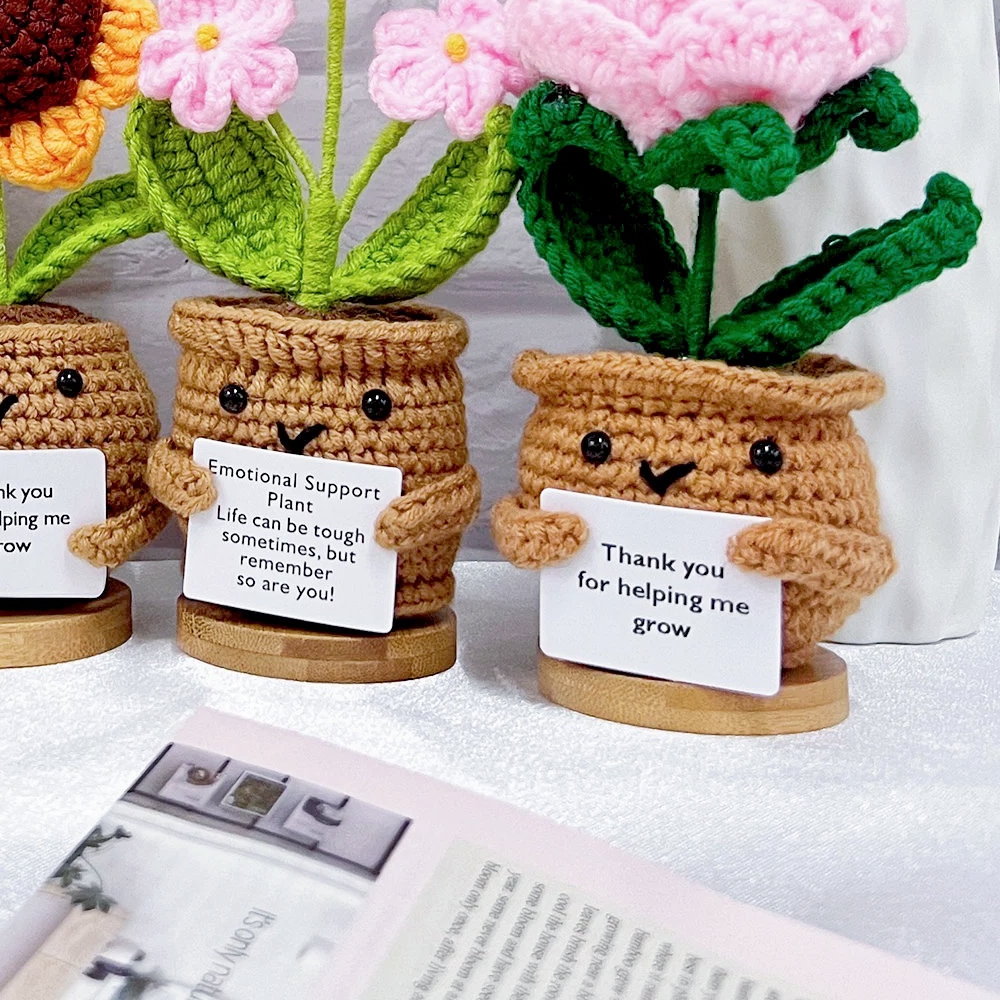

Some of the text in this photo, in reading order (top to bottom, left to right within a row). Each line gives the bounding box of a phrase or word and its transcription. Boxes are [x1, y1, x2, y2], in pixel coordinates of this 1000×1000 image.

[208, 458, 381, 501] Emotional Support
[21, 487, 53, 504] you
[267, 491, 314, 513] Plant
[44, 514, 71, 525] me
[216, 504, 365, 546] Life can be tough
[221, 529, 357, 564] sometimes, but
[239, 554, 333, 581] remember
[601, 542, 725, 580] Thank you
[236, 575, 335, 602] so are you!
[577, 570, 750, 615] for helping me
[632, 616, 692, 639] grow
[473, 859, 502, 890] bloom
[456, 889, 483, 912] only
[487, 893, 510, 920] some
[525, 881, 546, 907] some
[551, 892, 572, 916] cool
[242, 907, 277, 928] It's
[443, 910, 469, 938] once,
[509, 906, 537, 938] bloom
[543, 913, 564, 932] the
[572, 903, 599, 935] leaves
[214, 928, 255, 964] only
[473, 918, 496, 947] never
[530, 930, 556, 961] house
[589, 913, 622, 957] growing
[433, 936, 457, 961] after
[499, 937, 518, 959] and
[560, 934, 586, 965] brush
[620, 927, 651, 969] bamboo
[410, 960, 446, 992] living
[456, 946, 486, 980] bloom
[487, 957, 511, 982] have
[518, 960, 540, 986] with
[552, 963, 573, 981] the
[584, 956, 603, 979] near
[450, 979, 465, 991] at
